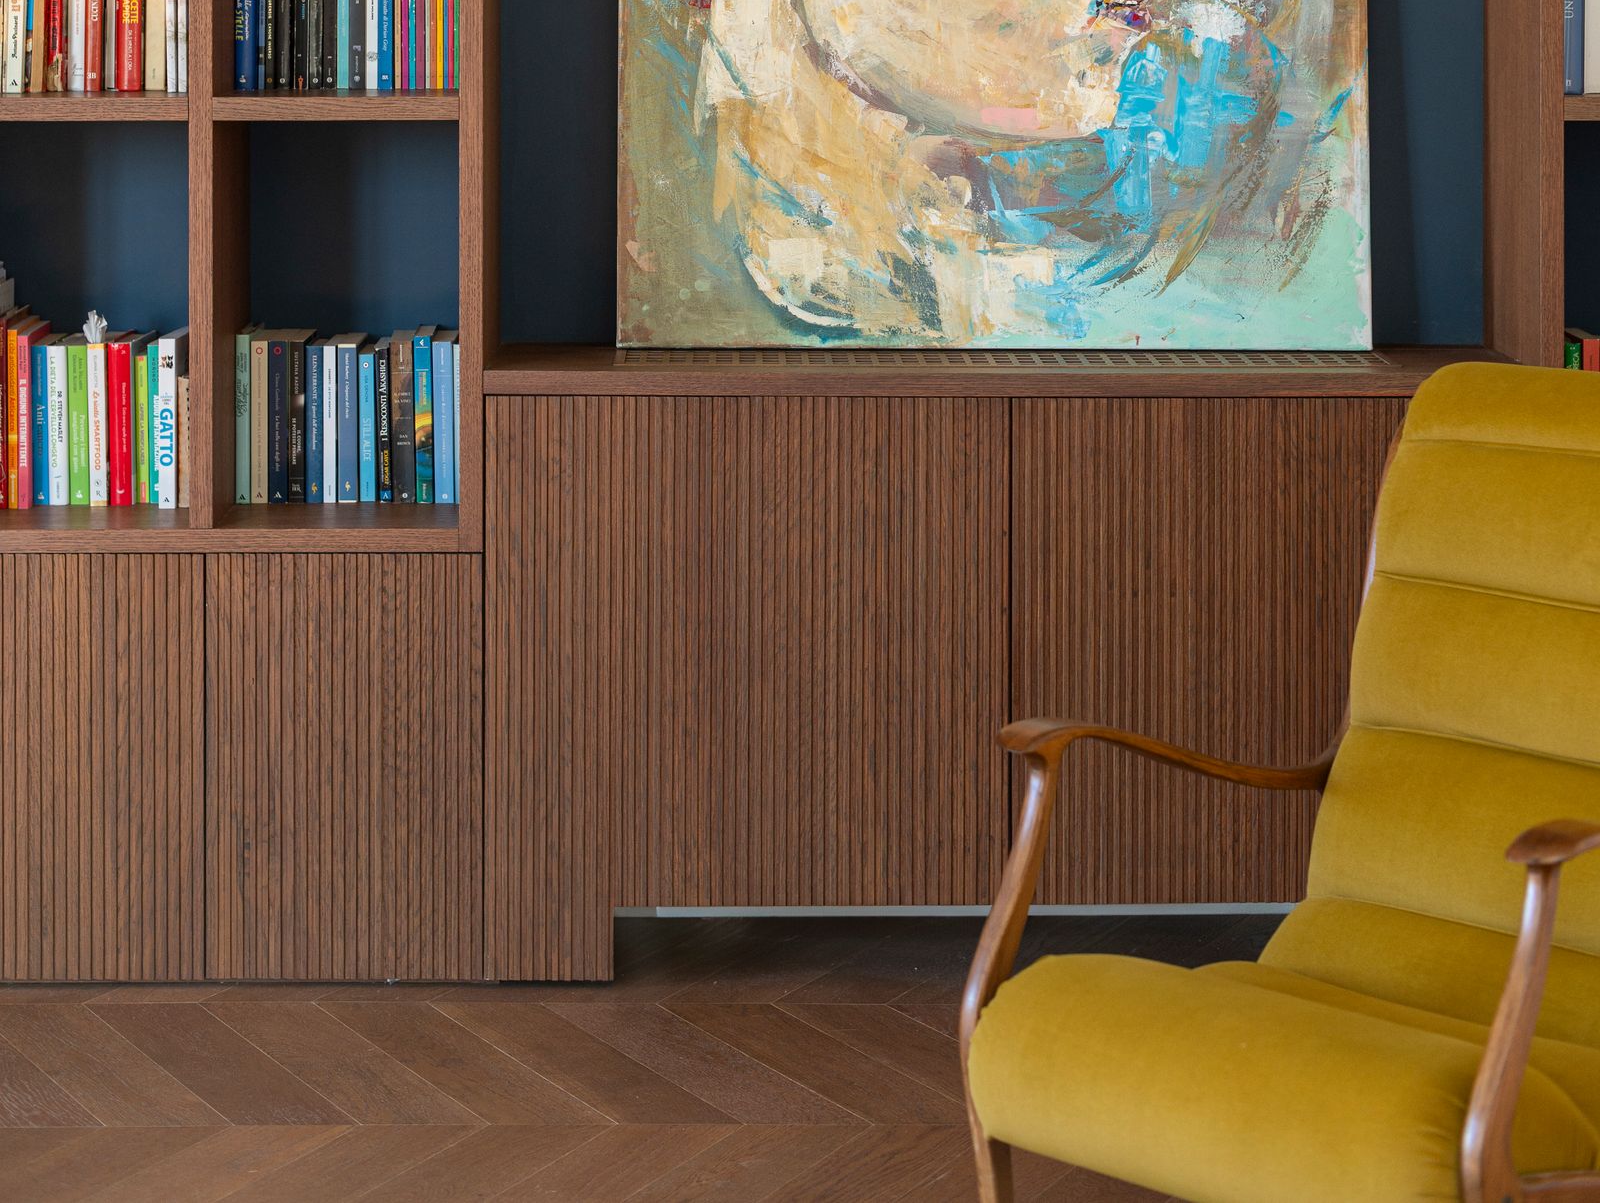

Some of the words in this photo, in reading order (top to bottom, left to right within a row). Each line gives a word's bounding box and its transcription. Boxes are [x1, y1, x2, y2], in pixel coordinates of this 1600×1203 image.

[160, 408, 173, 467] GATTO
[362, 418, 370, 439] STILL
[362, 440, 370, 462] ALICE
